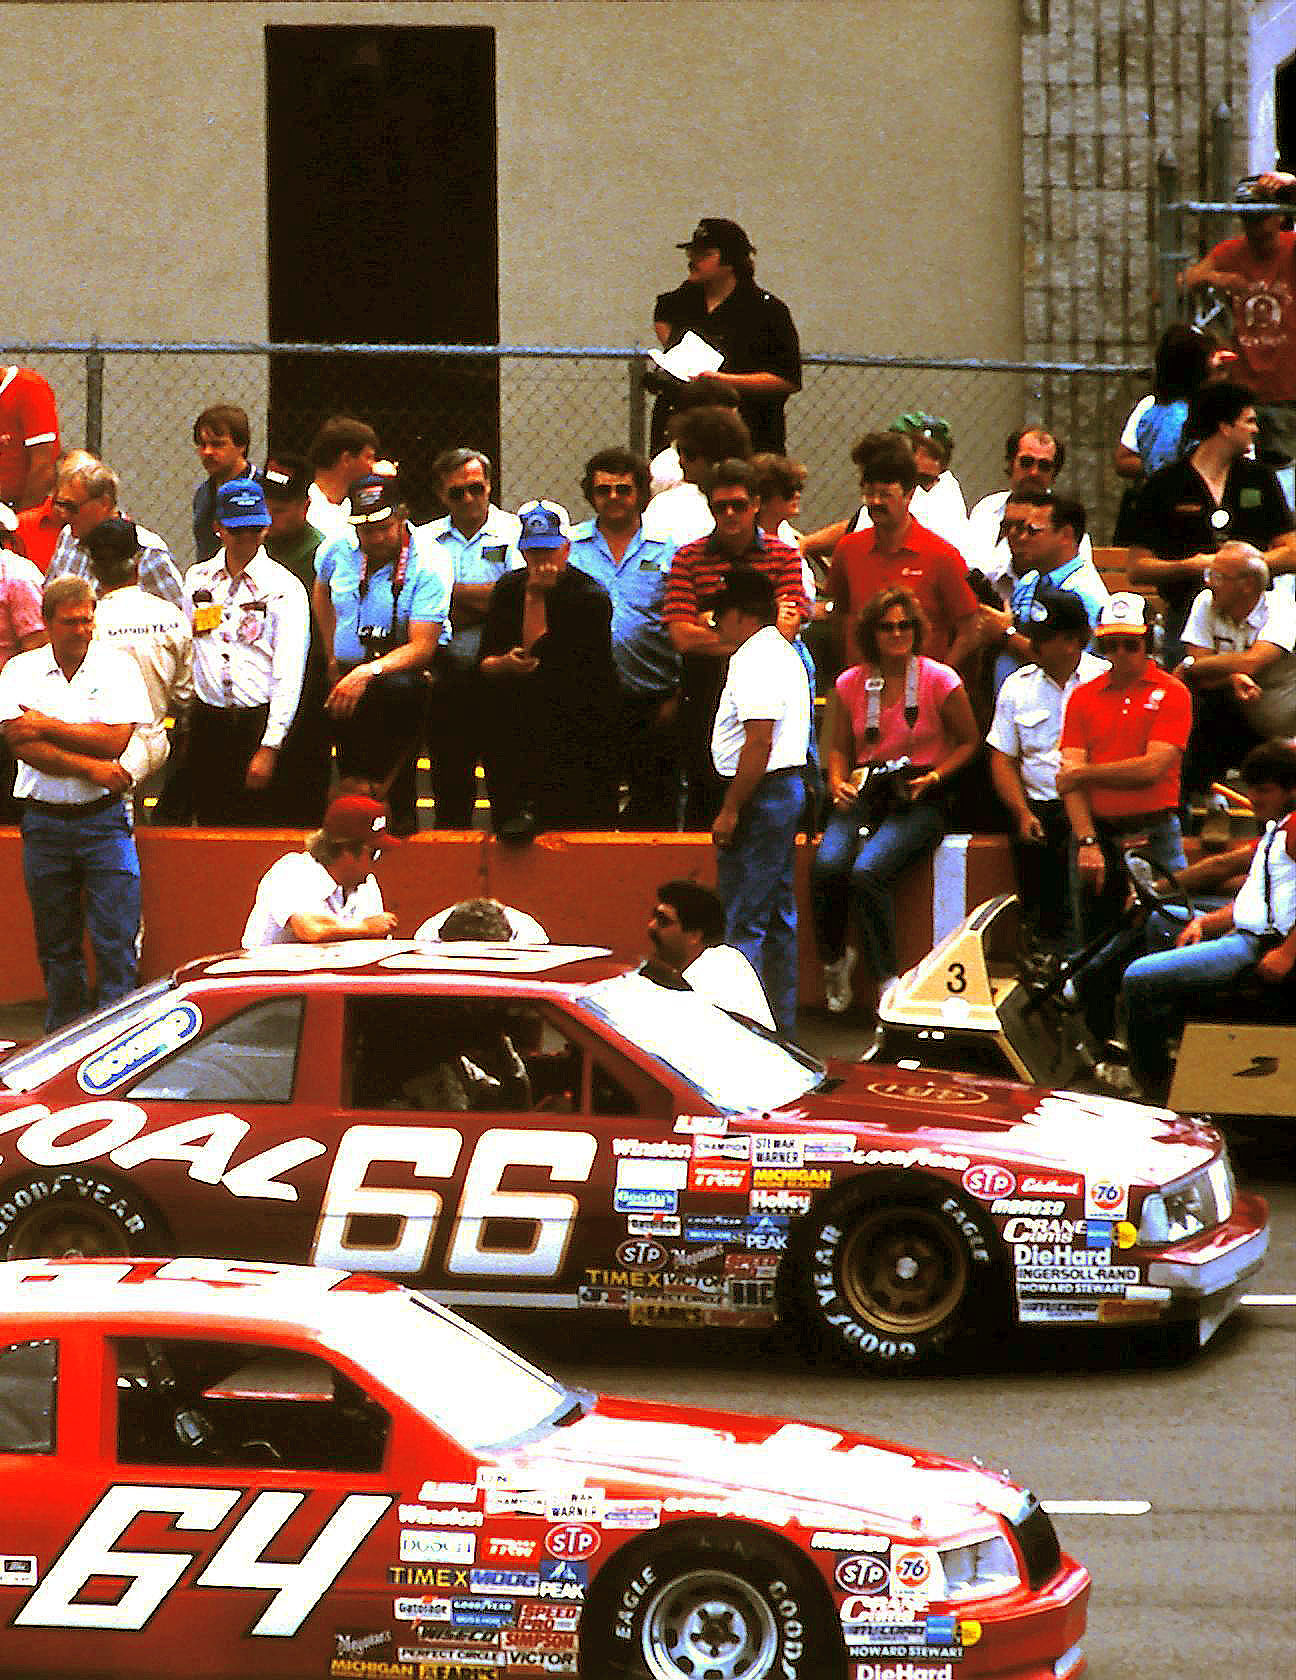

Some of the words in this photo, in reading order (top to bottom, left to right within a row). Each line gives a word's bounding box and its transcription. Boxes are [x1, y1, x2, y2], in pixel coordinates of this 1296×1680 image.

[946, 963, 967, 993] 3
[969, 1168, 1010, 1194] STP
[312, 1125, 598, 1277] 66
[1097, 1185, 1118, 1201] 76
[746, 1235, 788, 1250] PEAK
[624, 1243, 661, 1264] STP
[1015, 1245, 1111, 1266] DieHard
[585, 1269, 662, 1288] TIMEX
[553, 1527, 593, 1554] STP
[9, 1483, 396, 1639] 64
[903, 1560, 925, 1577] 76
[389, 1567, 469, 1588] TIMEX
[843, 1559, 884, 1586] STP
[539, 1581, 584, 1600] PEAK
[615, 1565, 656, 1640] EAGLE
[509, 1652, 574, 1666] VICTOR
[849, 1646, 906, 1657] HOWARD
[857, 1663, 952, 1680] DieHard
